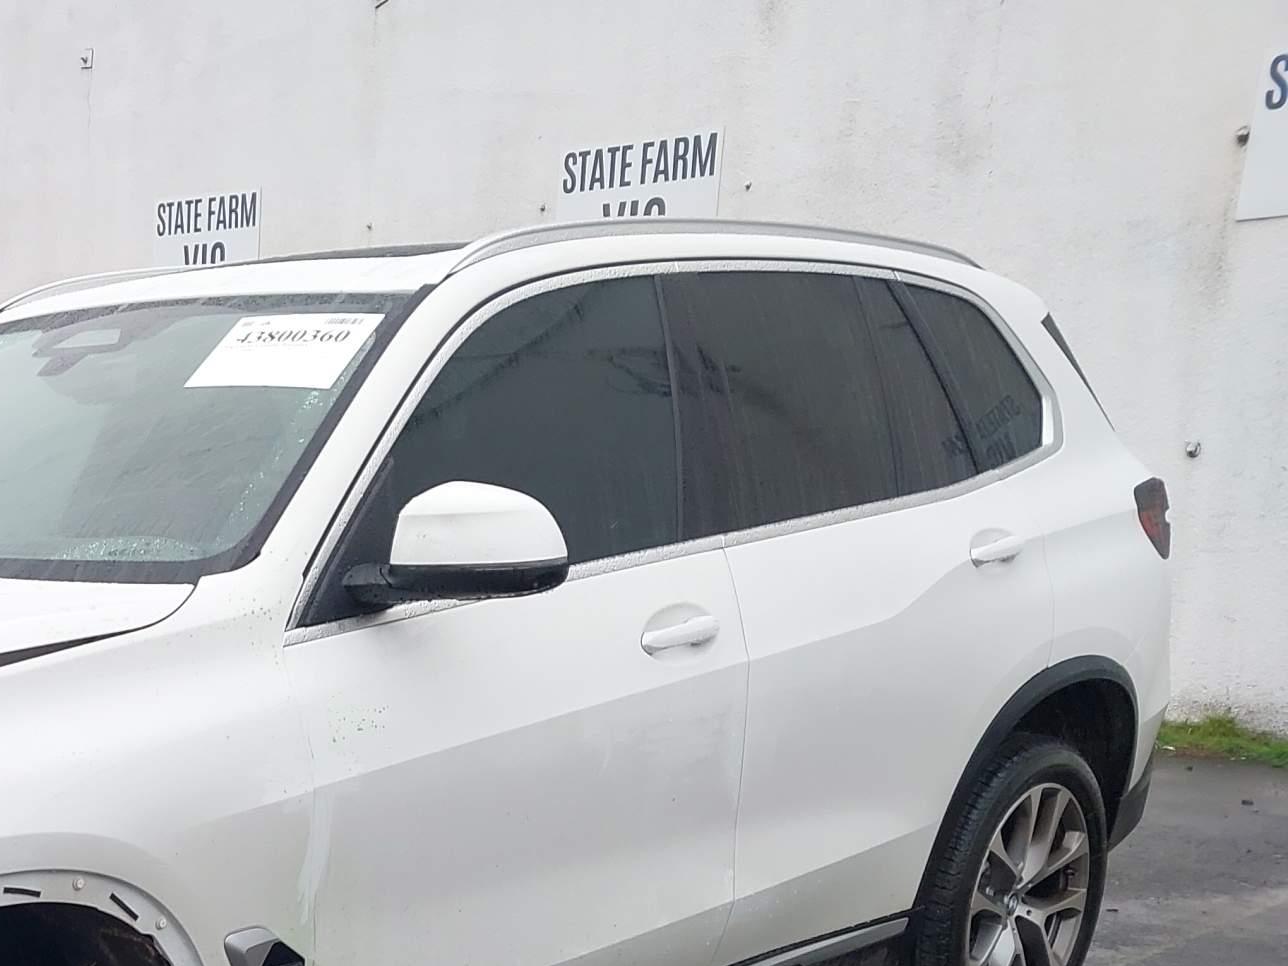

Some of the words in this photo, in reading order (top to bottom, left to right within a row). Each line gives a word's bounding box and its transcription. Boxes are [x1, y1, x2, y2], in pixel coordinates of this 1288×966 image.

[563, 144, 634, 194] STATE
[640, 132, 718, 185] FARM
[156, 198, 203, 237] STATE
[207, 191, 257, 232] FARM
[236, 329, 351, 344] 43800360
